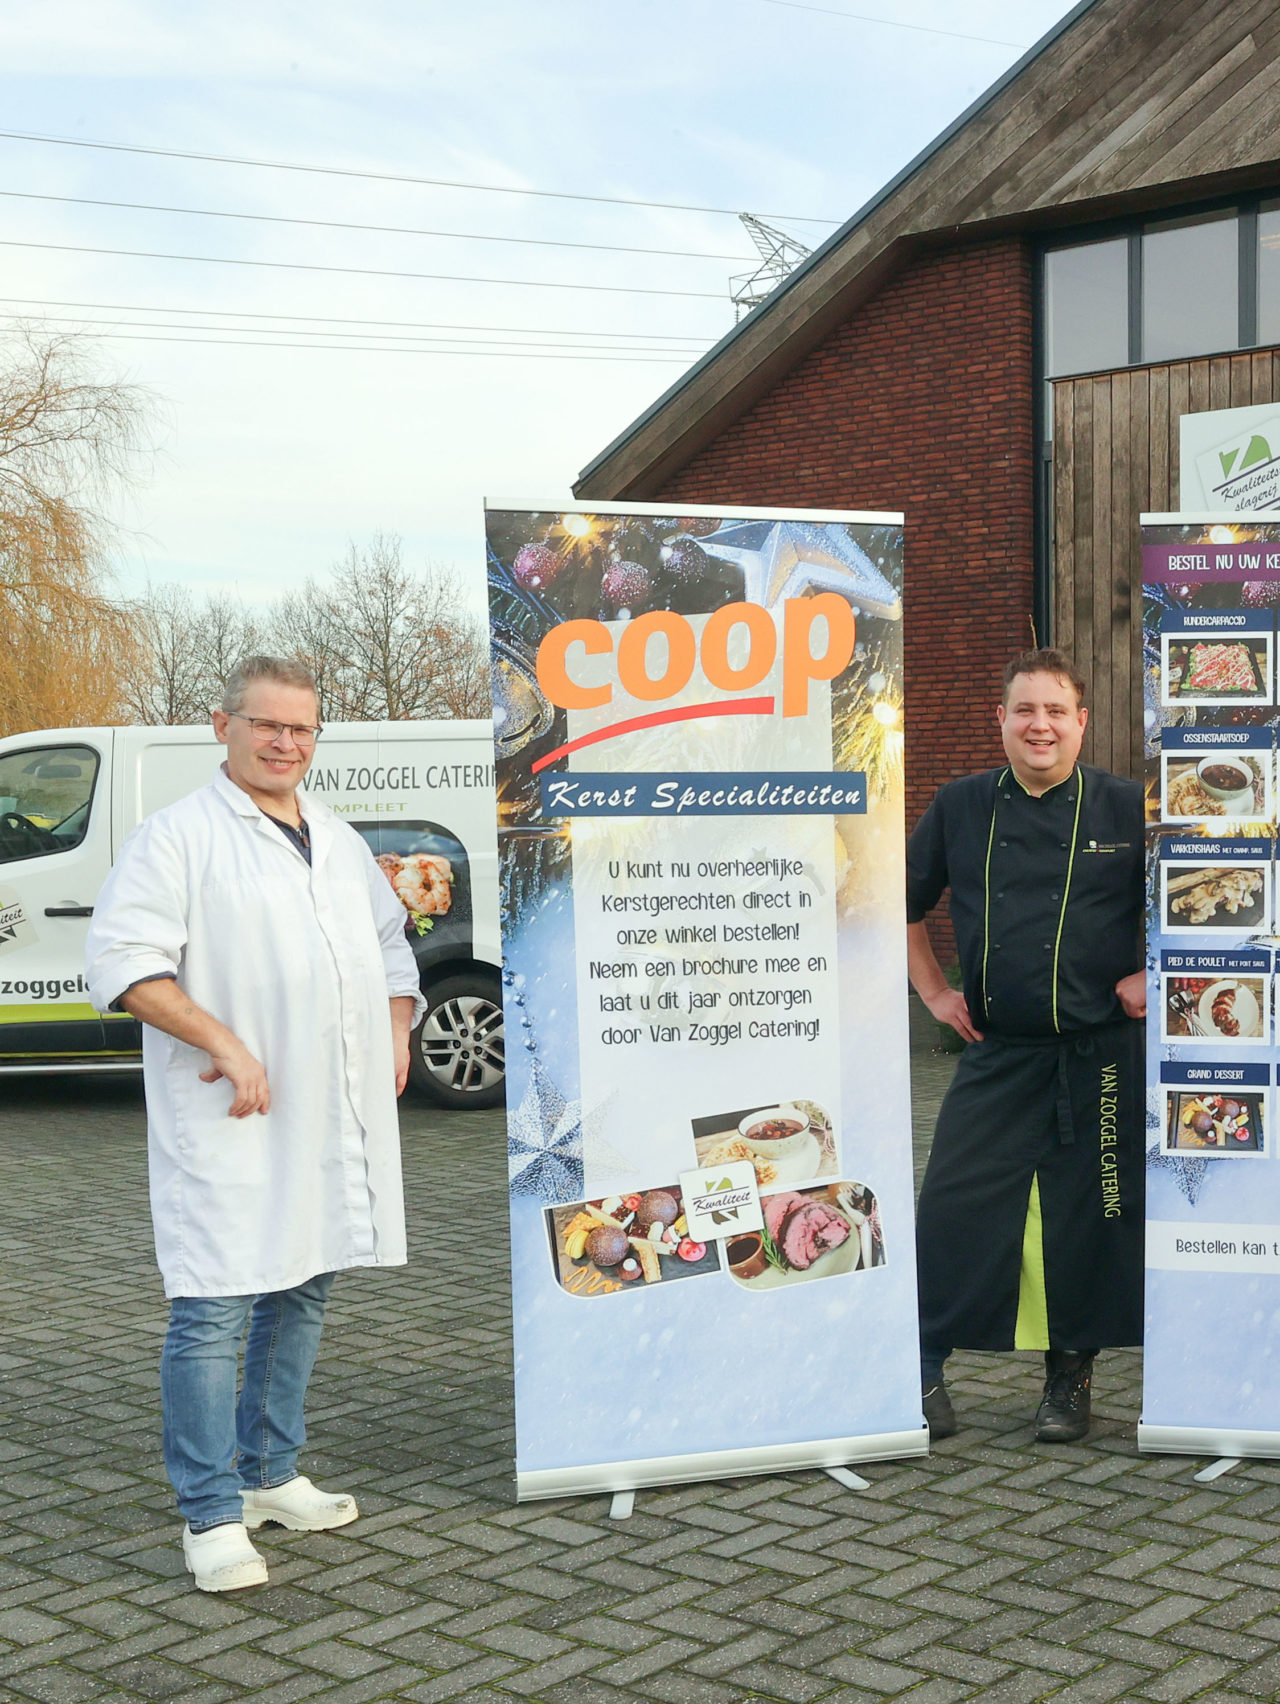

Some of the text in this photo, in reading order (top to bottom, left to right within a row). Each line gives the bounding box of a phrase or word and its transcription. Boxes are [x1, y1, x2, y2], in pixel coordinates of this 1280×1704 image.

[1235, 483, 1278, 511] slagerij
[1168, 555, 1210, 571] BESTEL
[1216, 554, 1234, 570] NU
[1238, 554, 1261, 569] UW
[1183, 615, 1247, 627] RUNDERCARPACCIO
[536, 592, 856, 718] coop
[1183, 733, 1250, 744] OSSENSTAARTSOEP
[303, 769, 339, 792] VAN
[345, 767, 421, 791] ZOGGEL
[327, 802, 408, 813] MPLEET
[548, 781, 861, 813] Kerst Specialiteiten
[1170, 844, 1220, 854] VARKENSHAAS
[608, 859, 803, 881] U kunt nu overheerlijke
[602, 891, 812, 916] Kerstgerechten direct in
[616, 922, 800, 945] onze winkel bestellen!
[590, 956, 827, 979] Neem een brochure mee en
[1167, 956, 1183, 967] PIED
[1185, 956, 1196, 967] DE
[1198, 956, 1226, 967] POULET
[600, 989, 812, 1014] laat u dit jaar ontzorgen
[601, 1018, 820, 1046] door Van Zoggel Catering!
[1187, 1069, 1244, 1080] GRAND DESSERT
[1100, 1063, 1121, 1218] VAN ZOGGEL CATERING
[693, 1192, 751, 1211] Kwaliteit
[1176, 1239, 1237, 1255] Bestellen
[1243, 1241, 1266, 1256] kan
